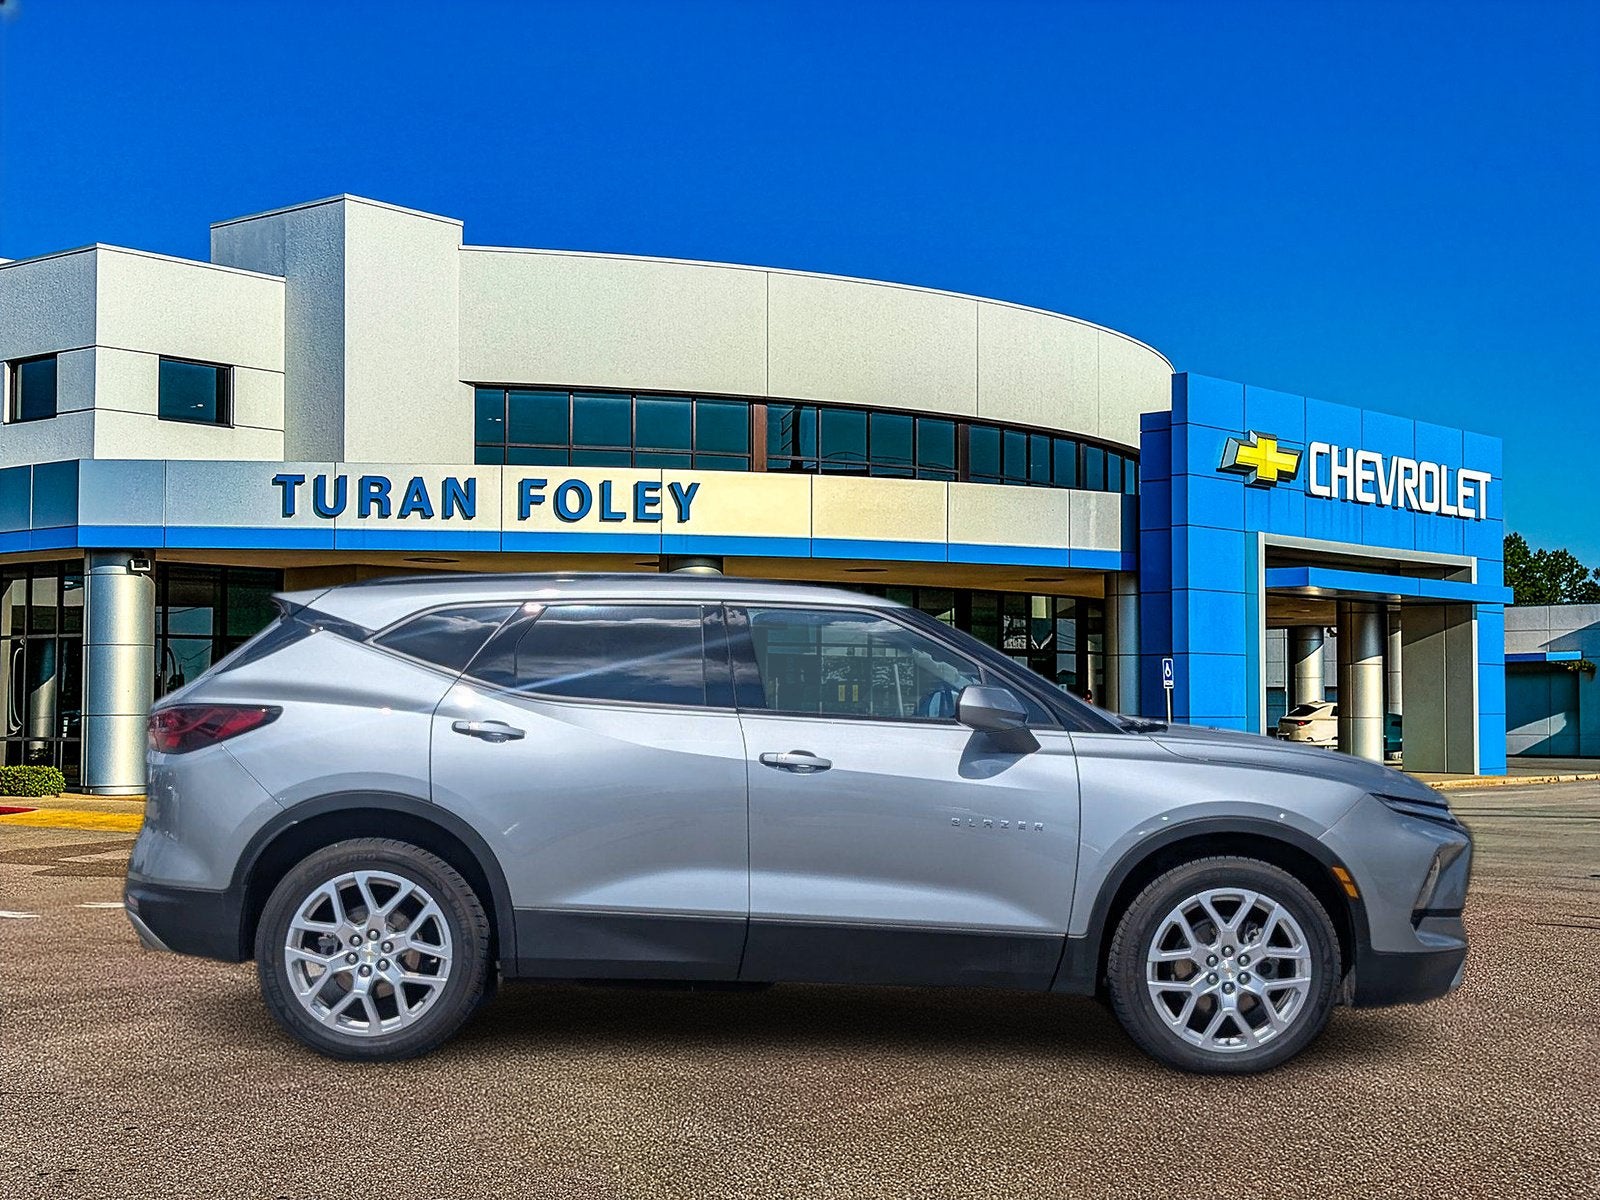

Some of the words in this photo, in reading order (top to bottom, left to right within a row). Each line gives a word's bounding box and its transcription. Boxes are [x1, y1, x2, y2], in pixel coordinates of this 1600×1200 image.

[272, 473, 477, 520] TURAN
[518, 478, 701, 523] FOLEY
[1308, 441, 1492, 520] CHEVROLET
[951, 817, 1043, 831] BLAZER
